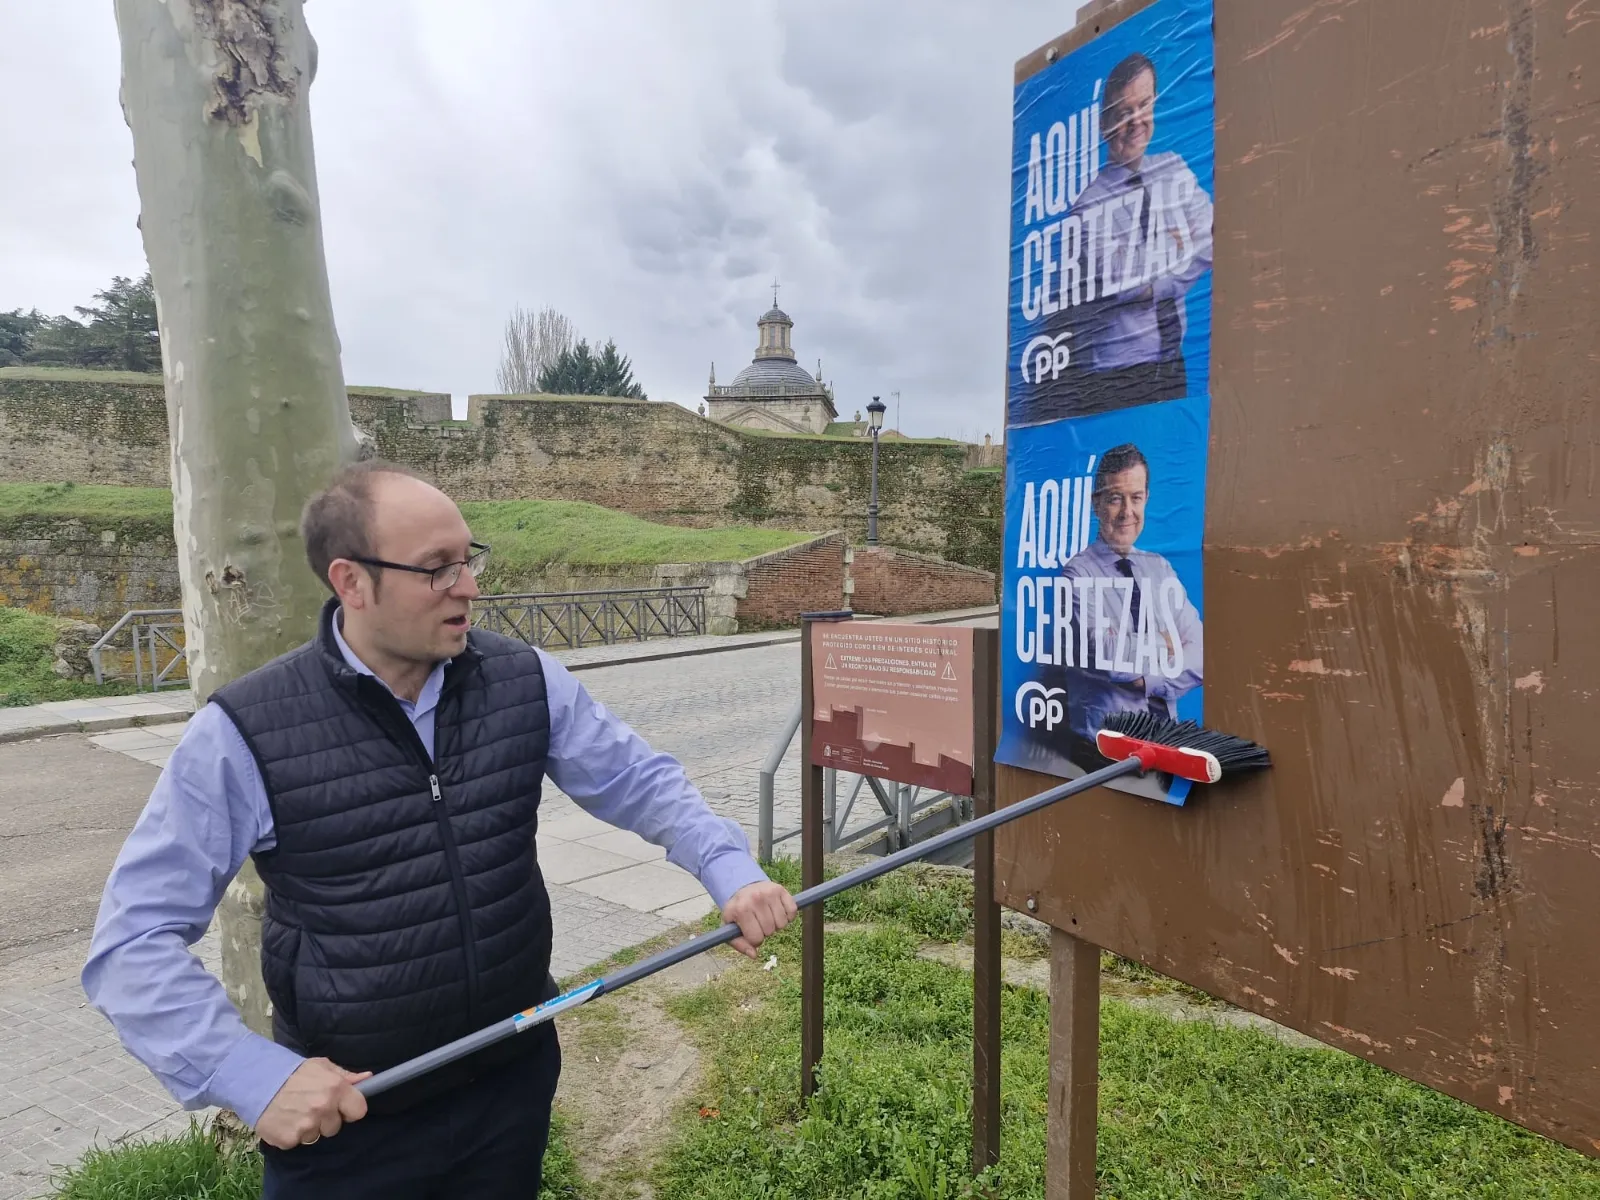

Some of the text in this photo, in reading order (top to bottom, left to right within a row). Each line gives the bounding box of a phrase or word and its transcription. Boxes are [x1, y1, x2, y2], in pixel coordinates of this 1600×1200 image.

[1024, 78, 1102, 226] AQUÍ
[1021, 174, 1196, 321] CERTEZAS
[1016, 454, 1097, 569] AQUÍ
[904, 637, 921, 645] SITIO
[924, 647, 958, 656] CULTURAL
[929, 661, 937, 669] EN
[1016, 575, 1185, 679] CERTEZAS
